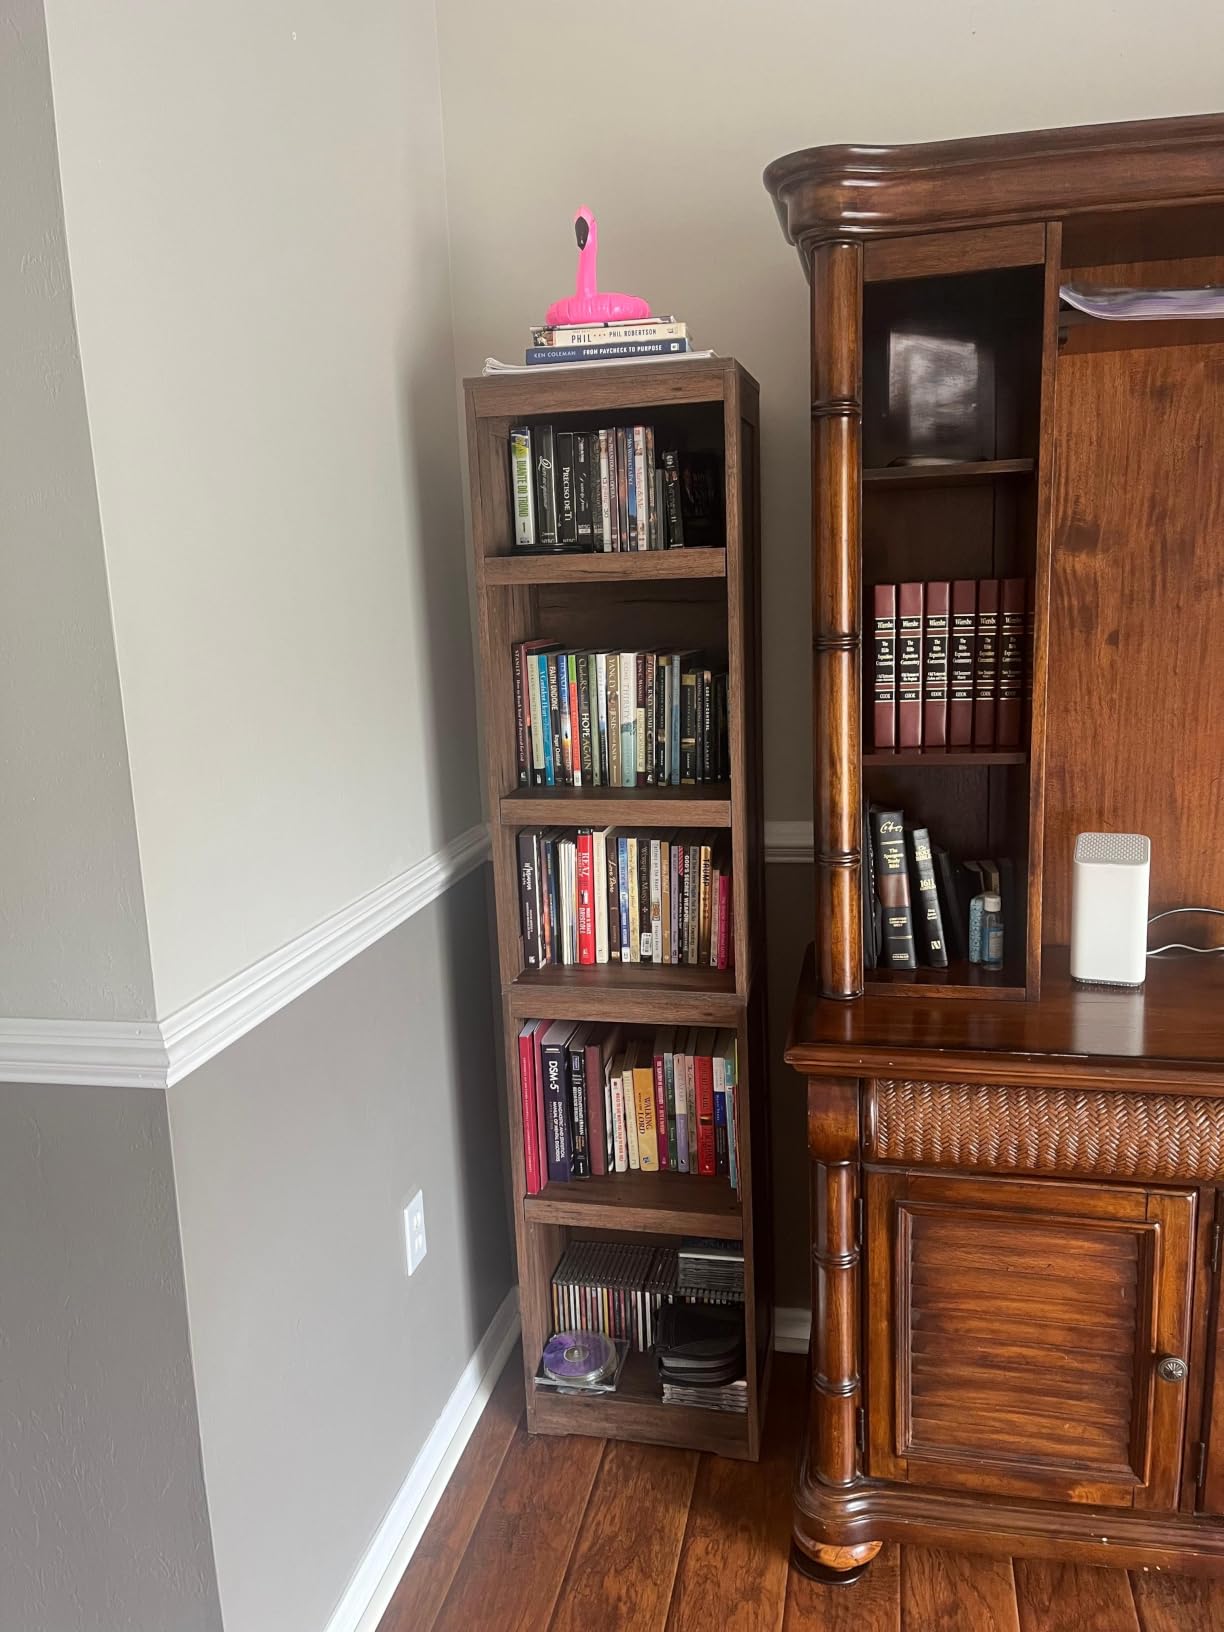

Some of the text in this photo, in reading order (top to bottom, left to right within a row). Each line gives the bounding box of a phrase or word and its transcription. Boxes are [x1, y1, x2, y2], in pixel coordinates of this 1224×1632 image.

[571, 328, 657, 344] PHIL PHIL ROBERTSON
[600, 346, 628, 354] PAYCHECK
[516, 460, 529, 517] DIANTE DO TRONO
[578, 658, 586, 681] Charles
[581, 713, 592, 770] HOPE AGAIN
[581, 852, 590, 878] REAL
[608, 860, 617, 875] Love
[609, 877, 617, 894] Dare
[920, 879, 935, 888] 1611
[548, 1060, 559, 1090] DSM-5
[638, 1112, 646, 1134] LORD
[644, 1096, 652, 1130] WALKING
